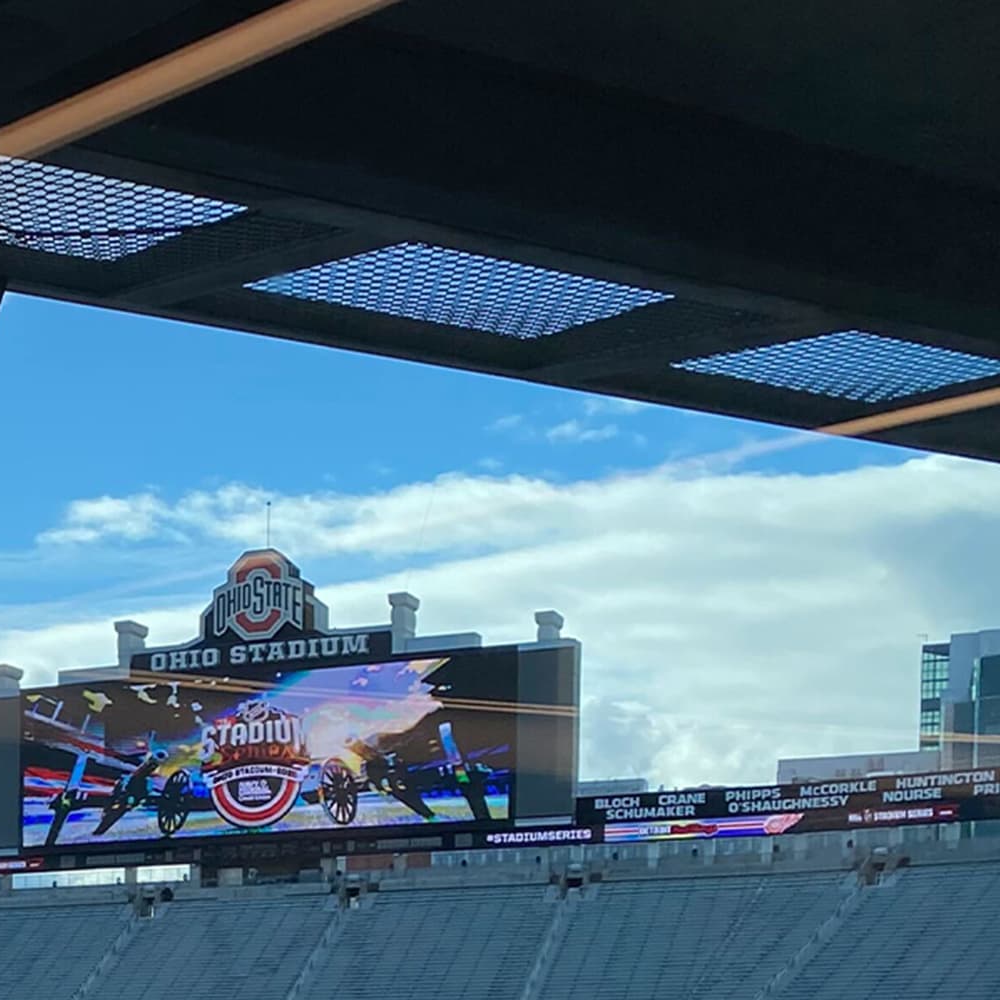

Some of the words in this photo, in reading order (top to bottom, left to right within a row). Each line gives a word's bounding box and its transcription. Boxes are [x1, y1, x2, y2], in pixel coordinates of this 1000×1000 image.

[150, 649, 220, 672] OHIO
[229, 635, 370, 665] STADIUM
[896, 770, 995, 789] HUNTINGTON
[725, 788, 781, 801] PHIPPS
[800, 780, 877, 797] McCORKLE
[882, 787, 942, 803] NOURSE
[594, 796, 640, 810] BLOCH
[658, 792, 706, 806] CRANE
[728, 795, 849, 814] O'SHAUGHNESSY
[606, 805, 696, 820] SCHUMAKER
[486, 829, 593, 844] #STADIUMSERIES
